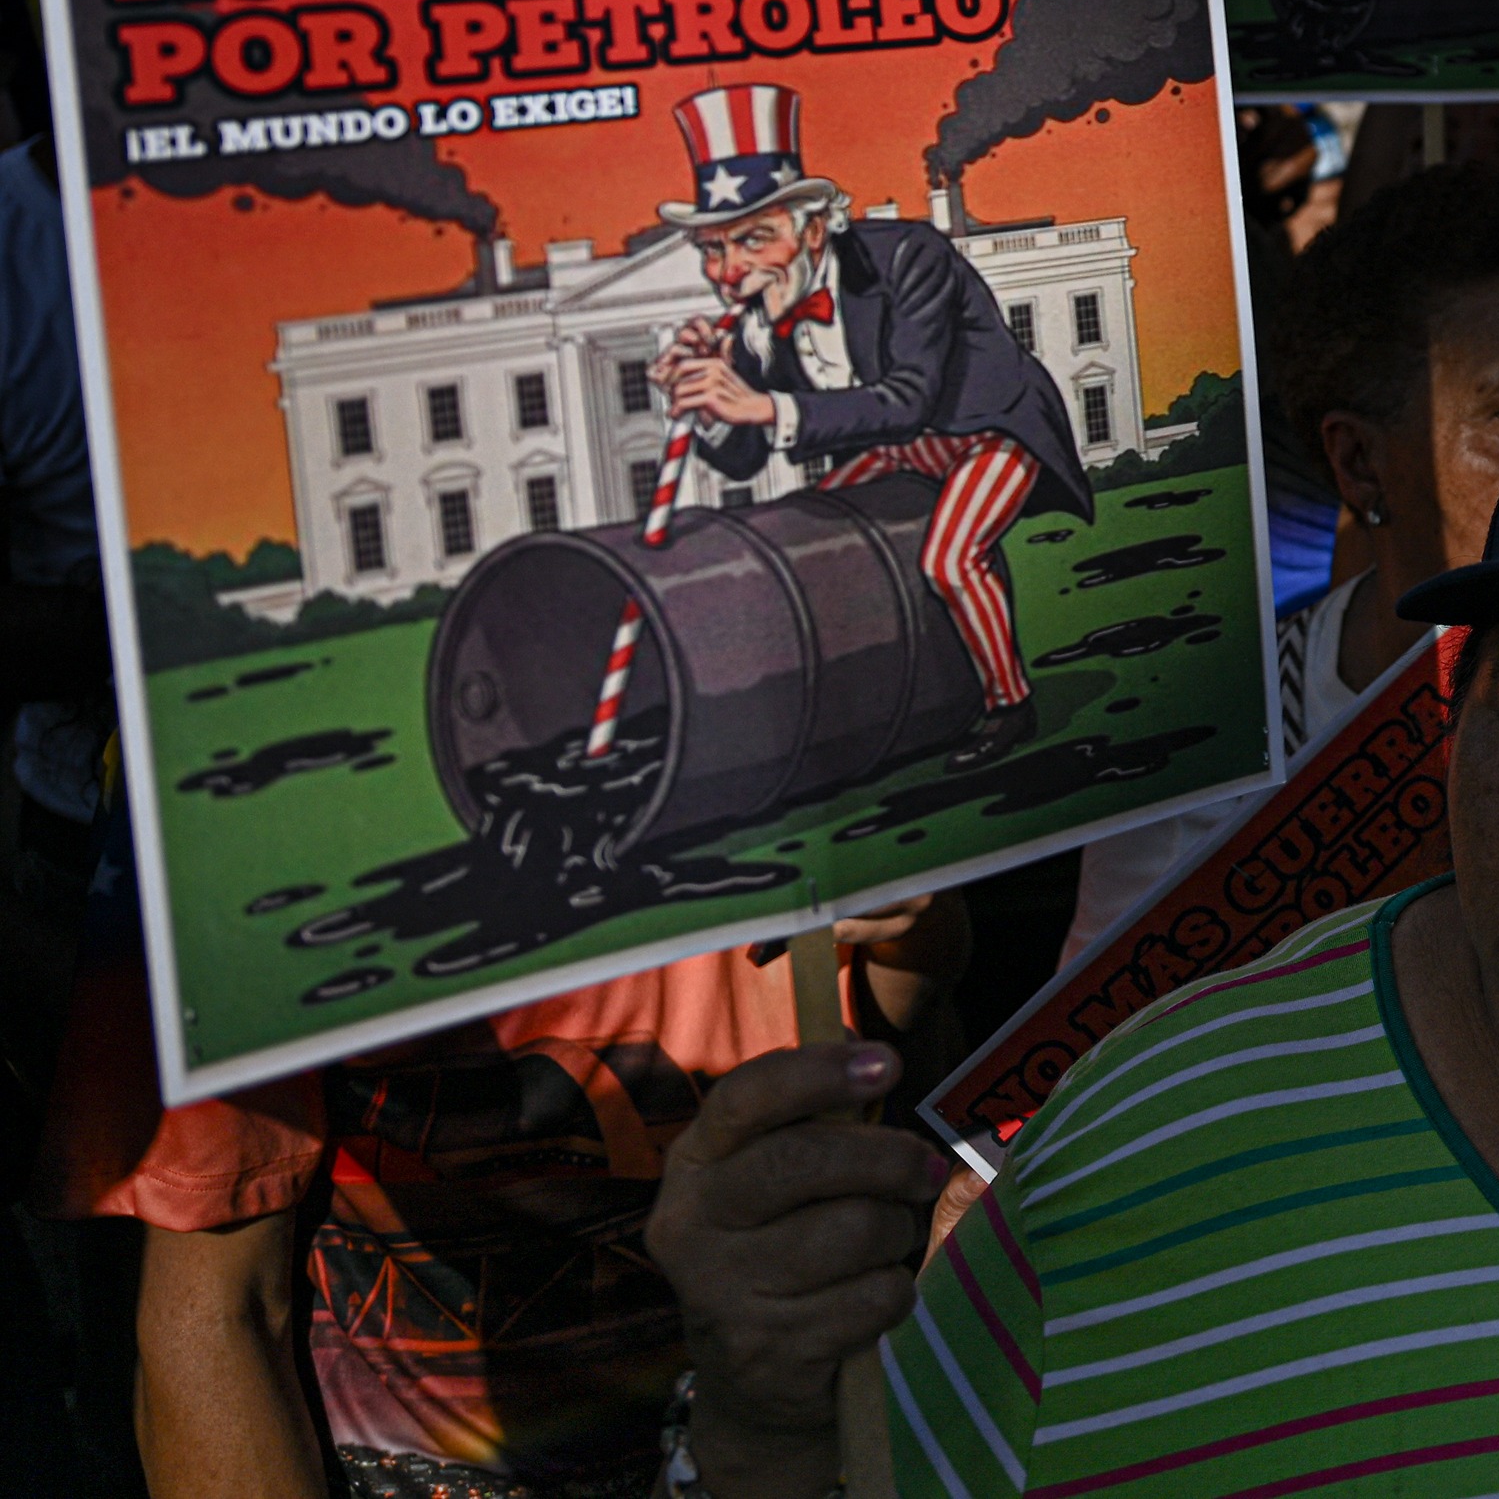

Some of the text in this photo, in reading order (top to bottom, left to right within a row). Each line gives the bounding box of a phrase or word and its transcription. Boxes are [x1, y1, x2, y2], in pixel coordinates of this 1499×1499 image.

[113, 5, 396, 108] POR
[126, 85, 639, 164] ¡EL MUNDO LO EXIGE!
[966, 1040, 1079, 1147] NO
[1223, 682, 1455, 914] GUERRA
